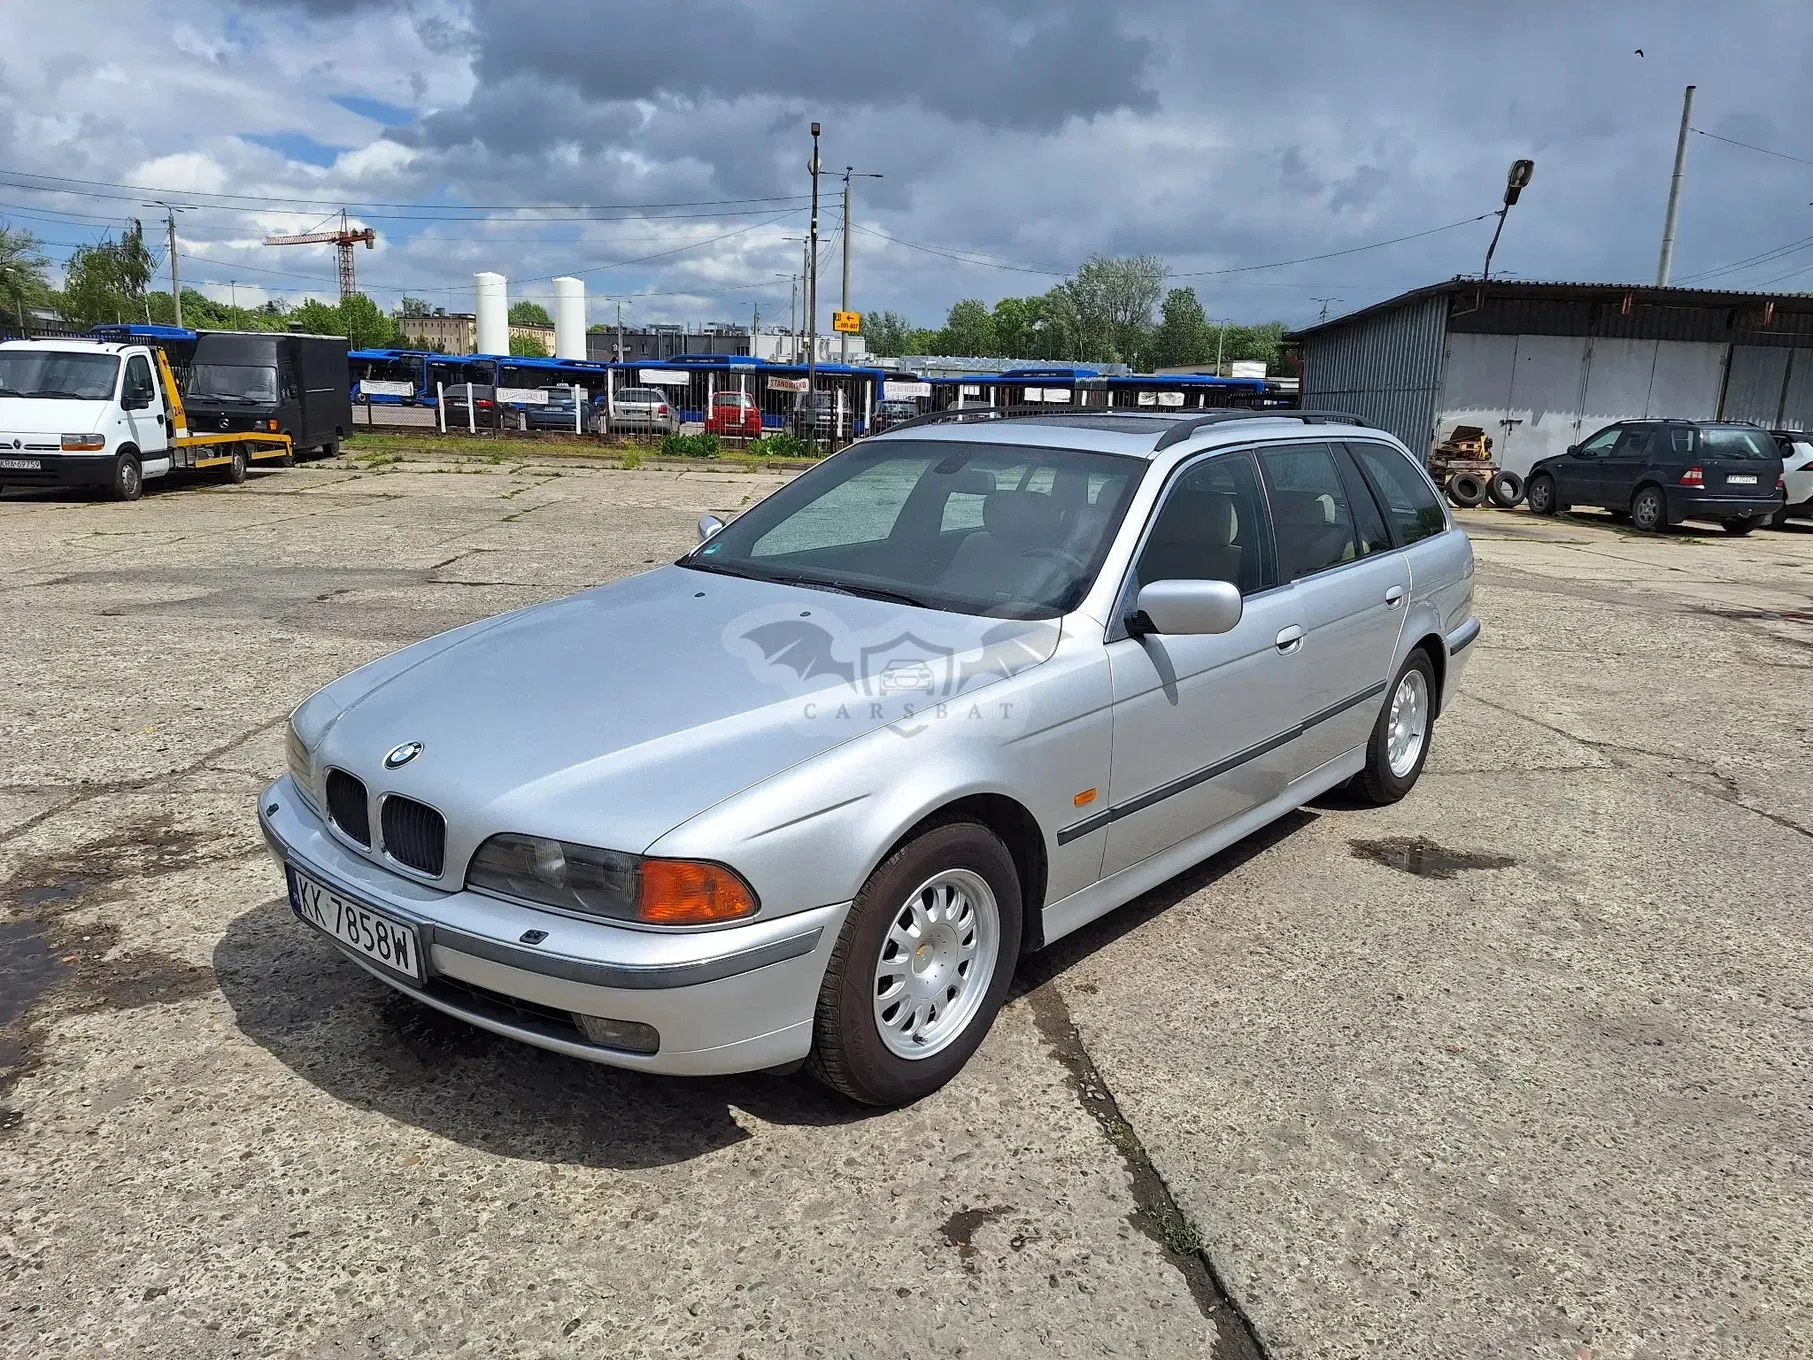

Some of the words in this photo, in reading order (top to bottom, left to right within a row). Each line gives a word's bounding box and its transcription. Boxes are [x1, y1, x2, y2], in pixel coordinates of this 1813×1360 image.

[770, 379, 806, 389] STANOWISKO
[17, 460, 40, 468] 69759
[299, 877, 327, 926] KK
[330, 897, 408, 969] 7858W
